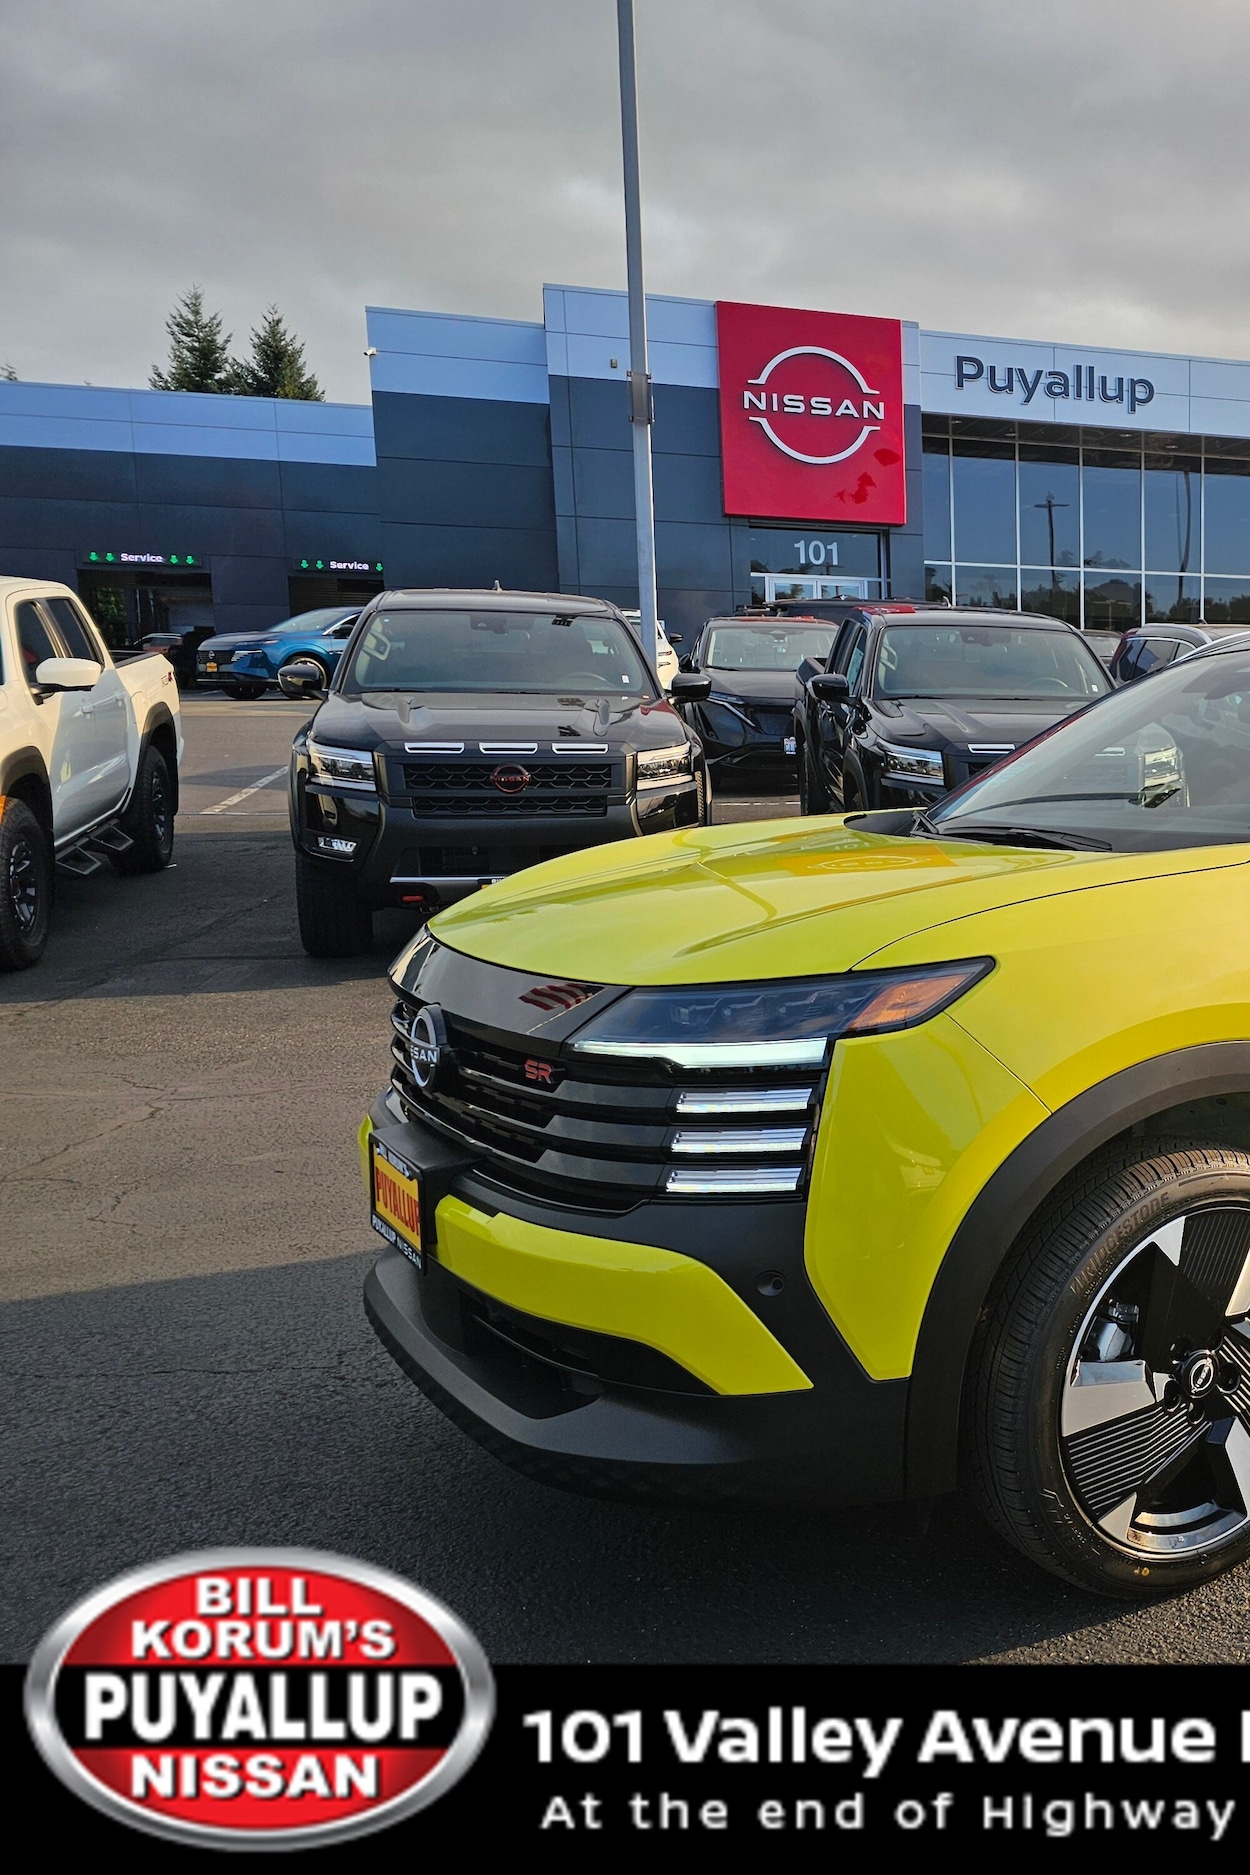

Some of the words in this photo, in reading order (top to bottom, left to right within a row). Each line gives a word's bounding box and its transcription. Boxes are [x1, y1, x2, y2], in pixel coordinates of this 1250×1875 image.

[954, 354, 1156, 413] Puyallup
[743, 390, 885, 420] NISSAN
[120, 552, 165, 564] Service
[329, 560, 370, 571] Service
[793, 539, 839, 566] 101
[524, 1059, 553, 1084] SR
[374, 1166, 421, 1237] PUYALLUP
